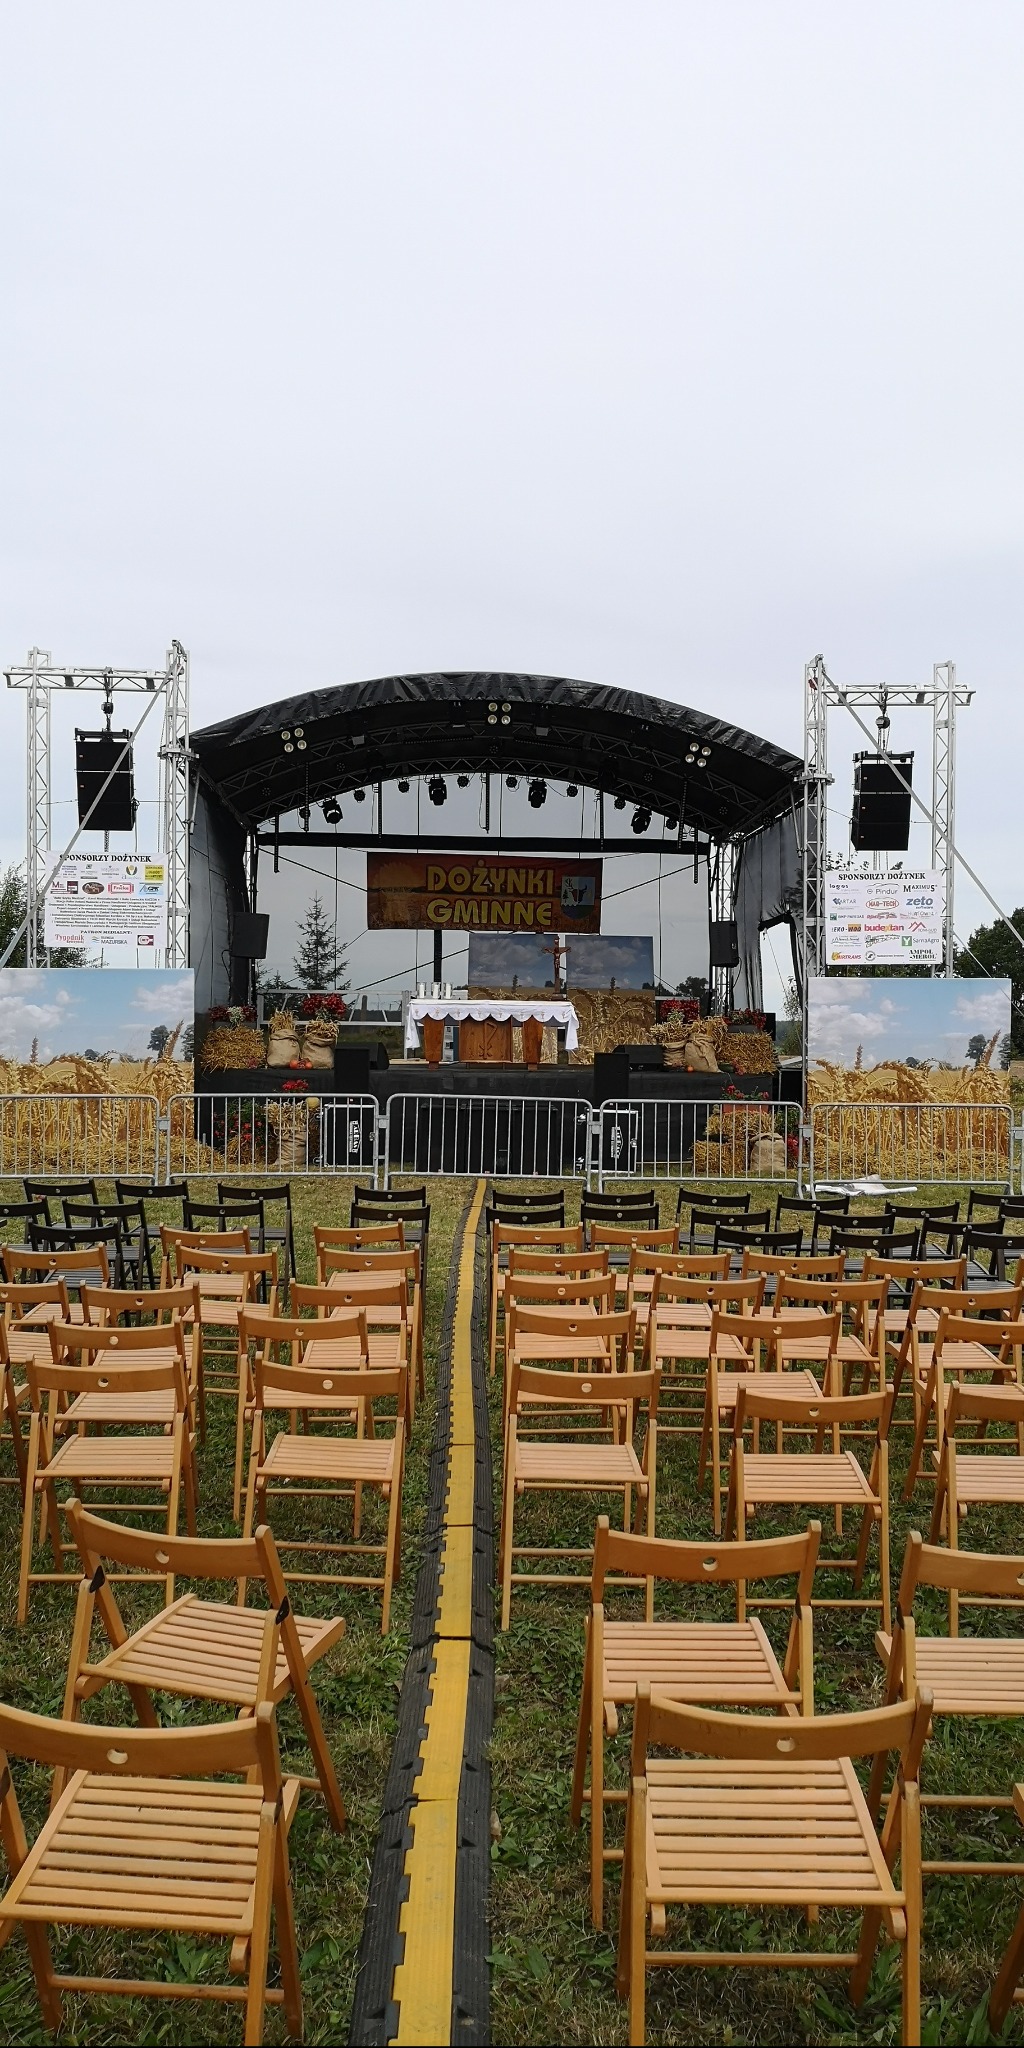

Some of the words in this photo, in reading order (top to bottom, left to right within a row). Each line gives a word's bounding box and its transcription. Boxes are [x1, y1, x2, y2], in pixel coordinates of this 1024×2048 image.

[112, 853, 151, 863] DOŻYNEK
[427, 860, 554, 895] DOŻYNKI
[887, 871, 926, 880] DOŻYNEK
[903, 884, 935, 893] MAXIMUS
[906, 896, 934, 906] zeto
[427, 899, 552, 926] GMINNE
